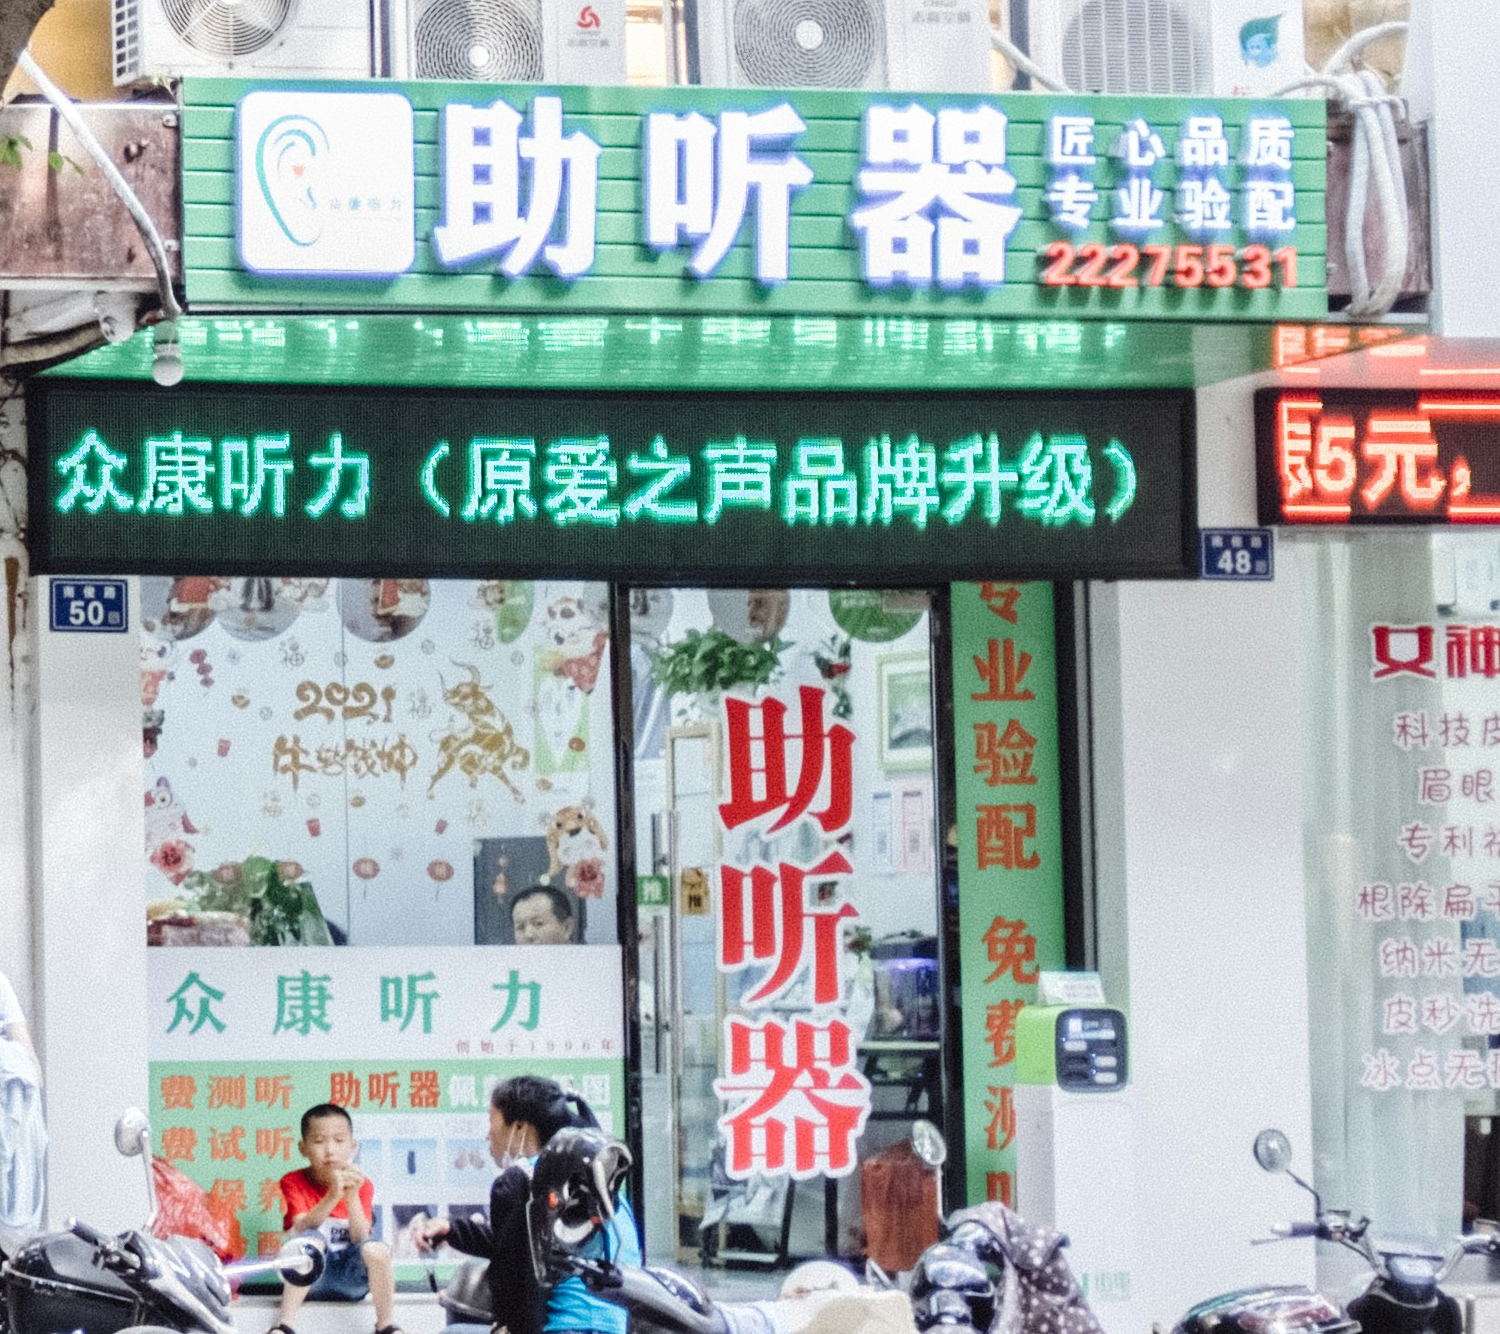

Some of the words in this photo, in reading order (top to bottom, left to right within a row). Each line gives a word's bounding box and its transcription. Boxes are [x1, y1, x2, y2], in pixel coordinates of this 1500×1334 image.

[1046, 115, 1295, 170] 匠心品质
[433, 96, 1023, 290] 助听器
[1045, 177, 1296, 234] 专业验配
[1043, 241, 1299, 289] 22275531
[1217, 549, 1252, 574] 48
[68, 600, 105, 626] 50
[293, 680, 397, 724] 2021
[718, 685, 865, 1172] 助听器
[165, 969, 543, 1036] 众康听力
[1363, 1051, 1500, 1087] 冰点无
